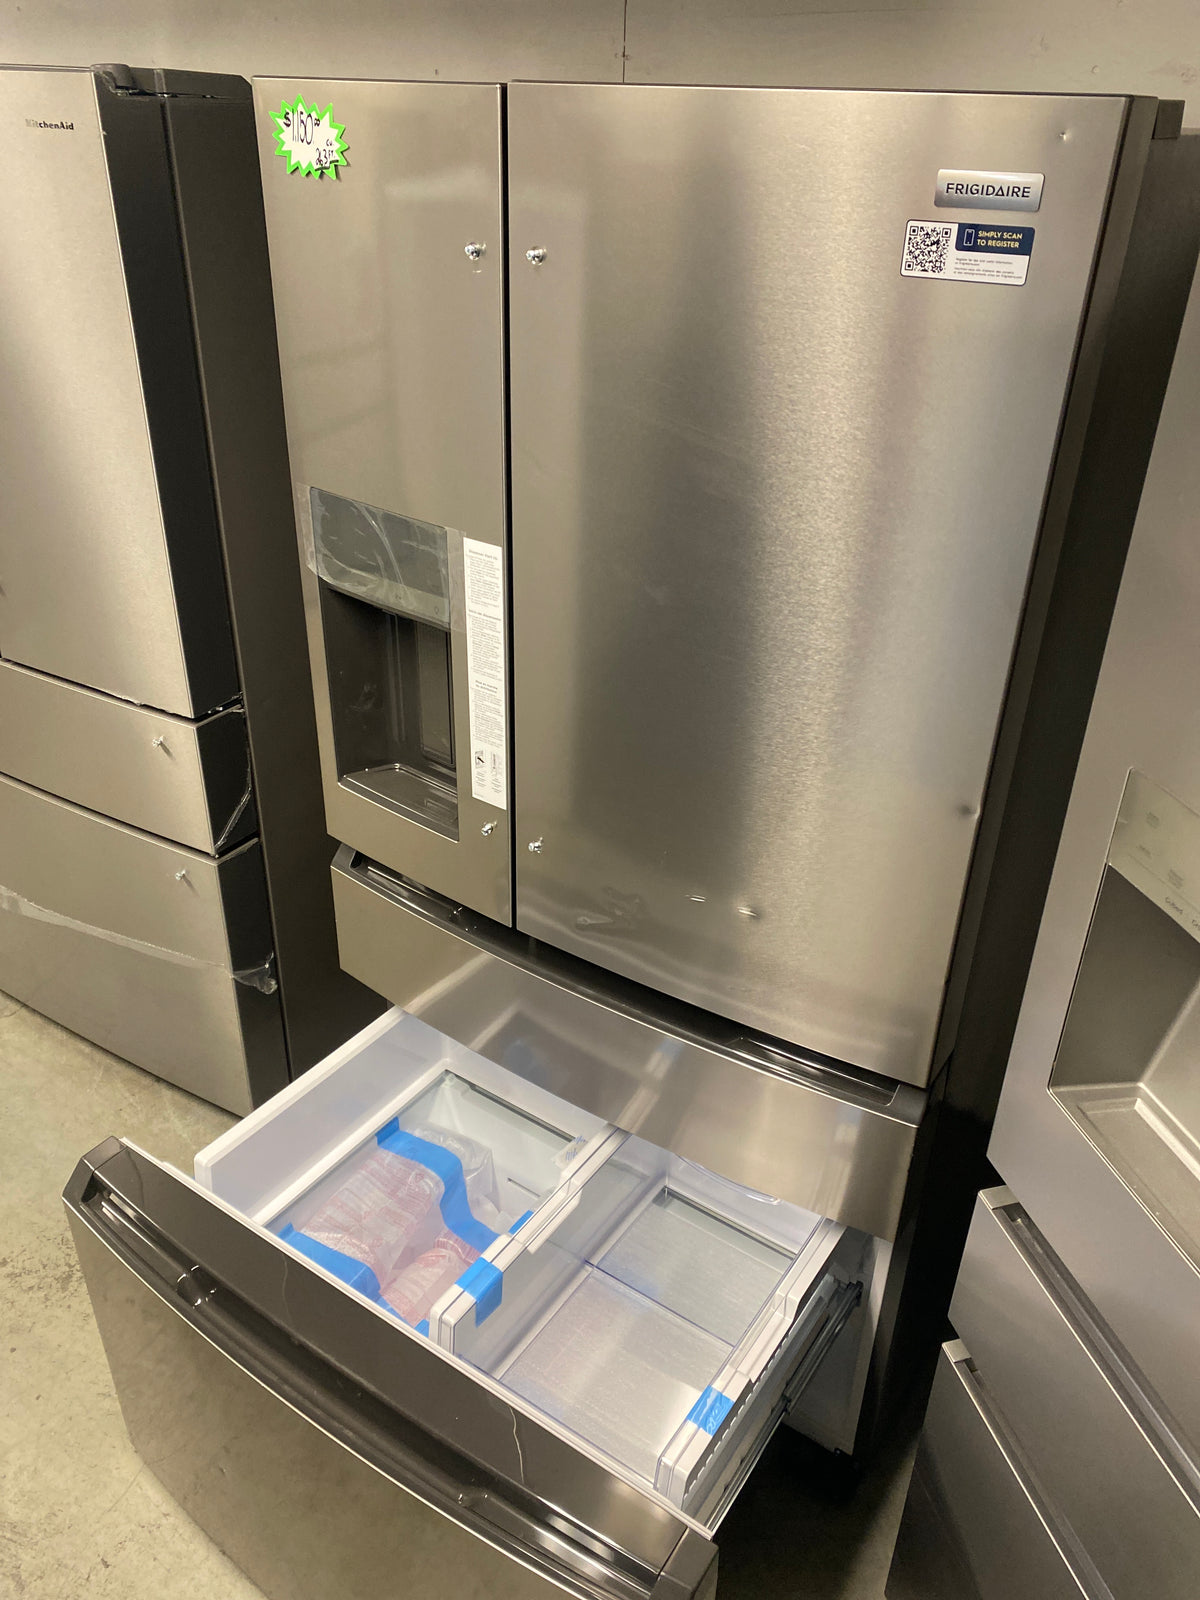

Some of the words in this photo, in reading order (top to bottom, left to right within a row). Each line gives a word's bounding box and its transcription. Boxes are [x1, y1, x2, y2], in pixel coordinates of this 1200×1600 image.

[25, 118, 75, 130] KitchenAid
[945, 182, 1031, 198] FRIGIDAIRE
[978, 230, 1002, 239] SIMPLY
[988, 240, 1019, 248] REGISTER
